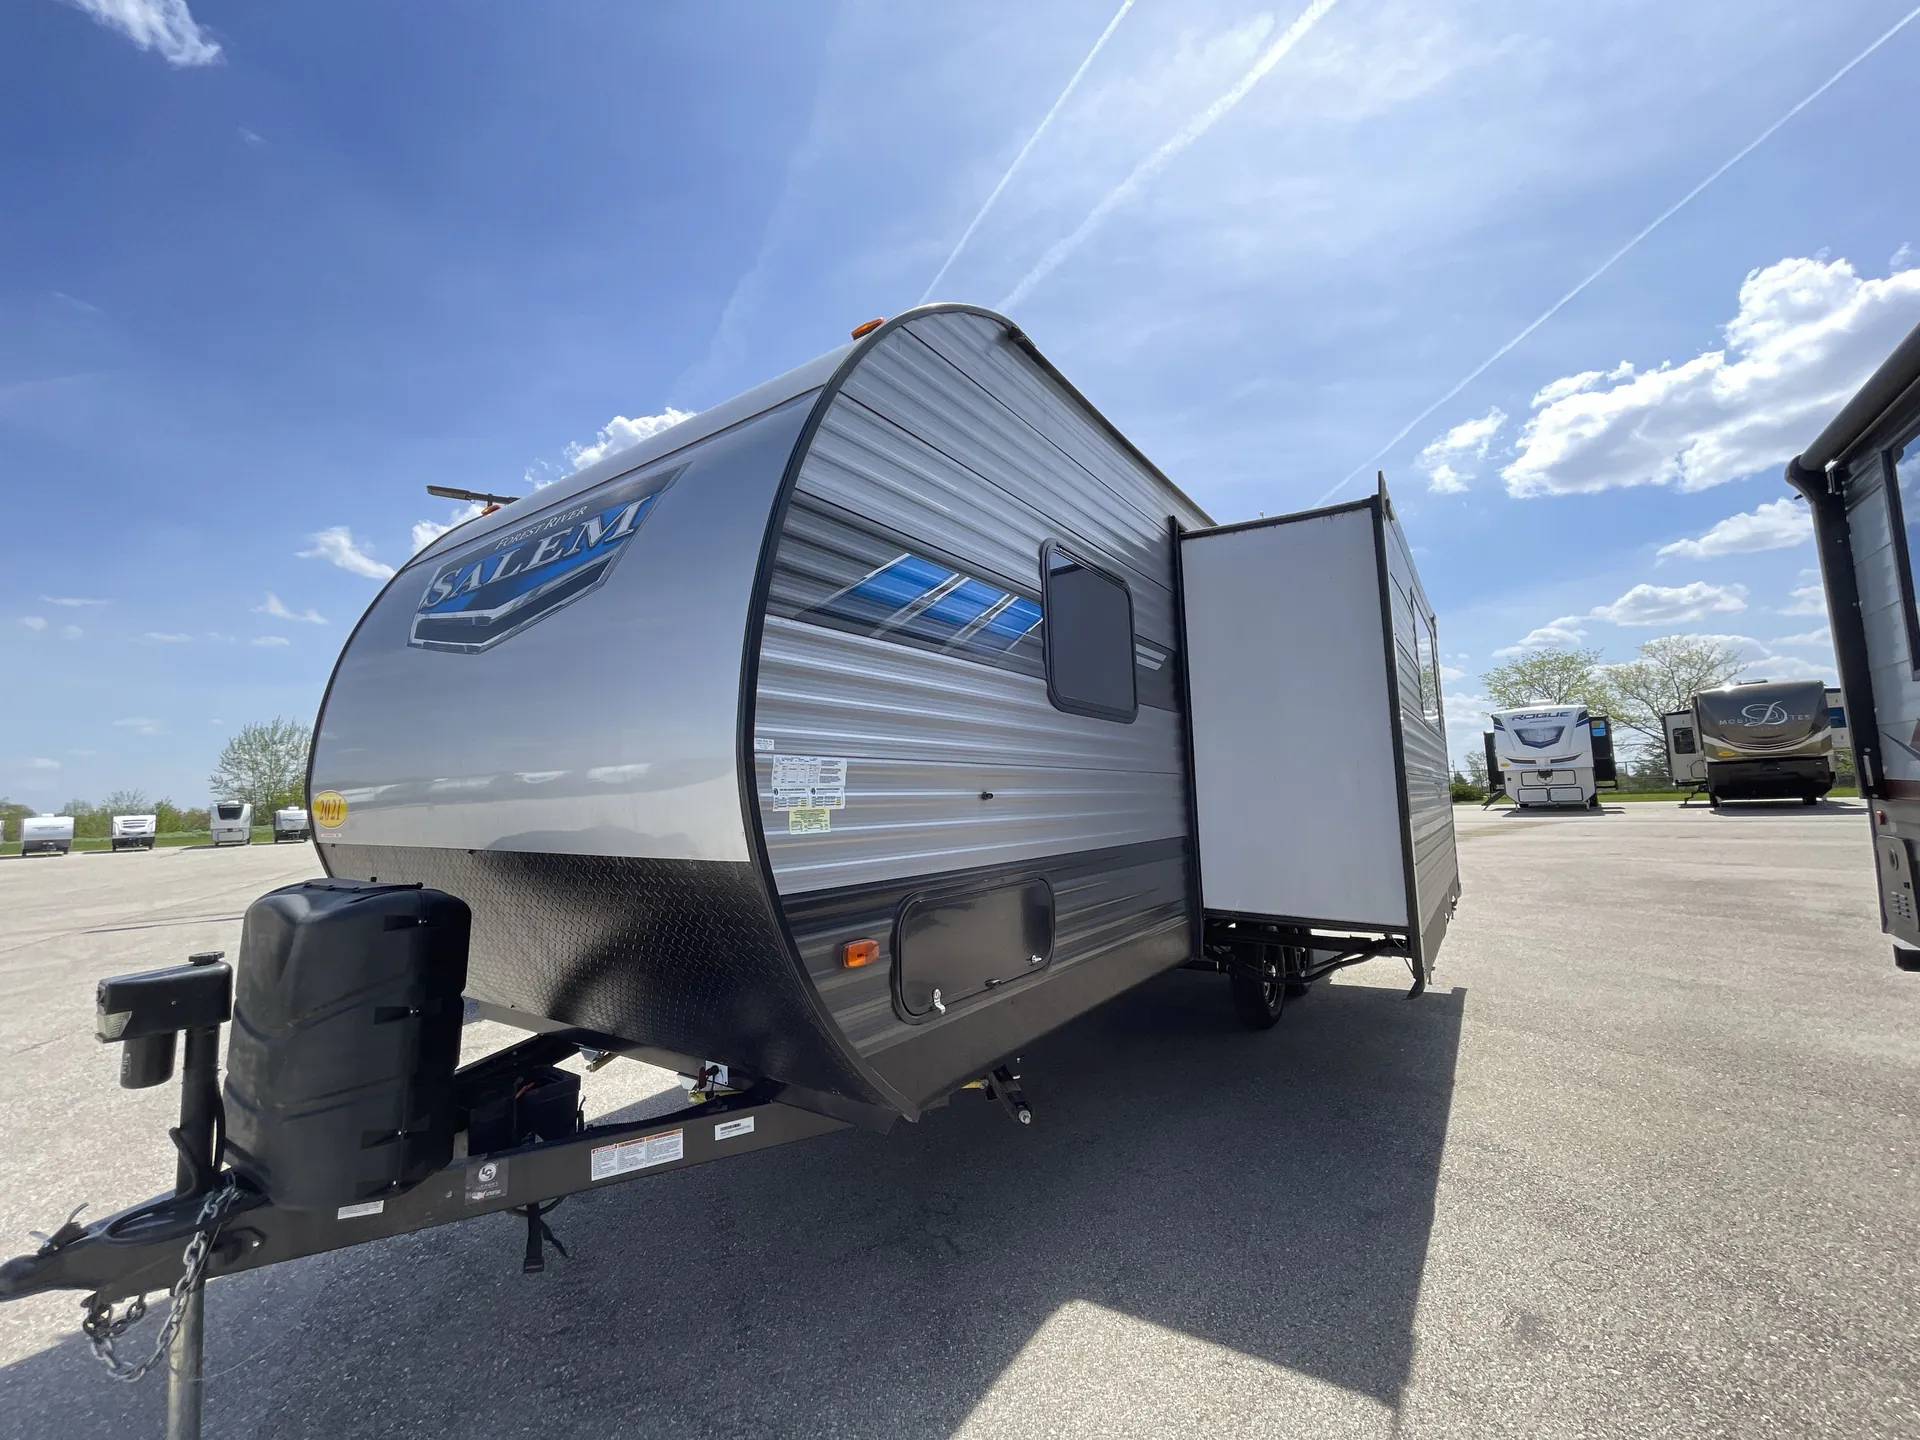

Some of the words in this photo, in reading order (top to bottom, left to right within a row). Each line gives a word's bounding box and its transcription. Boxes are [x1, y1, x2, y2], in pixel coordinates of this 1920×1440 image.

[494, 523, 545, 550] FOREST
[544, 506, 587, 530] RIVER
[424, 496, 650, 608] SALEM
[1511, 711, 1571, 721] ROGUE
